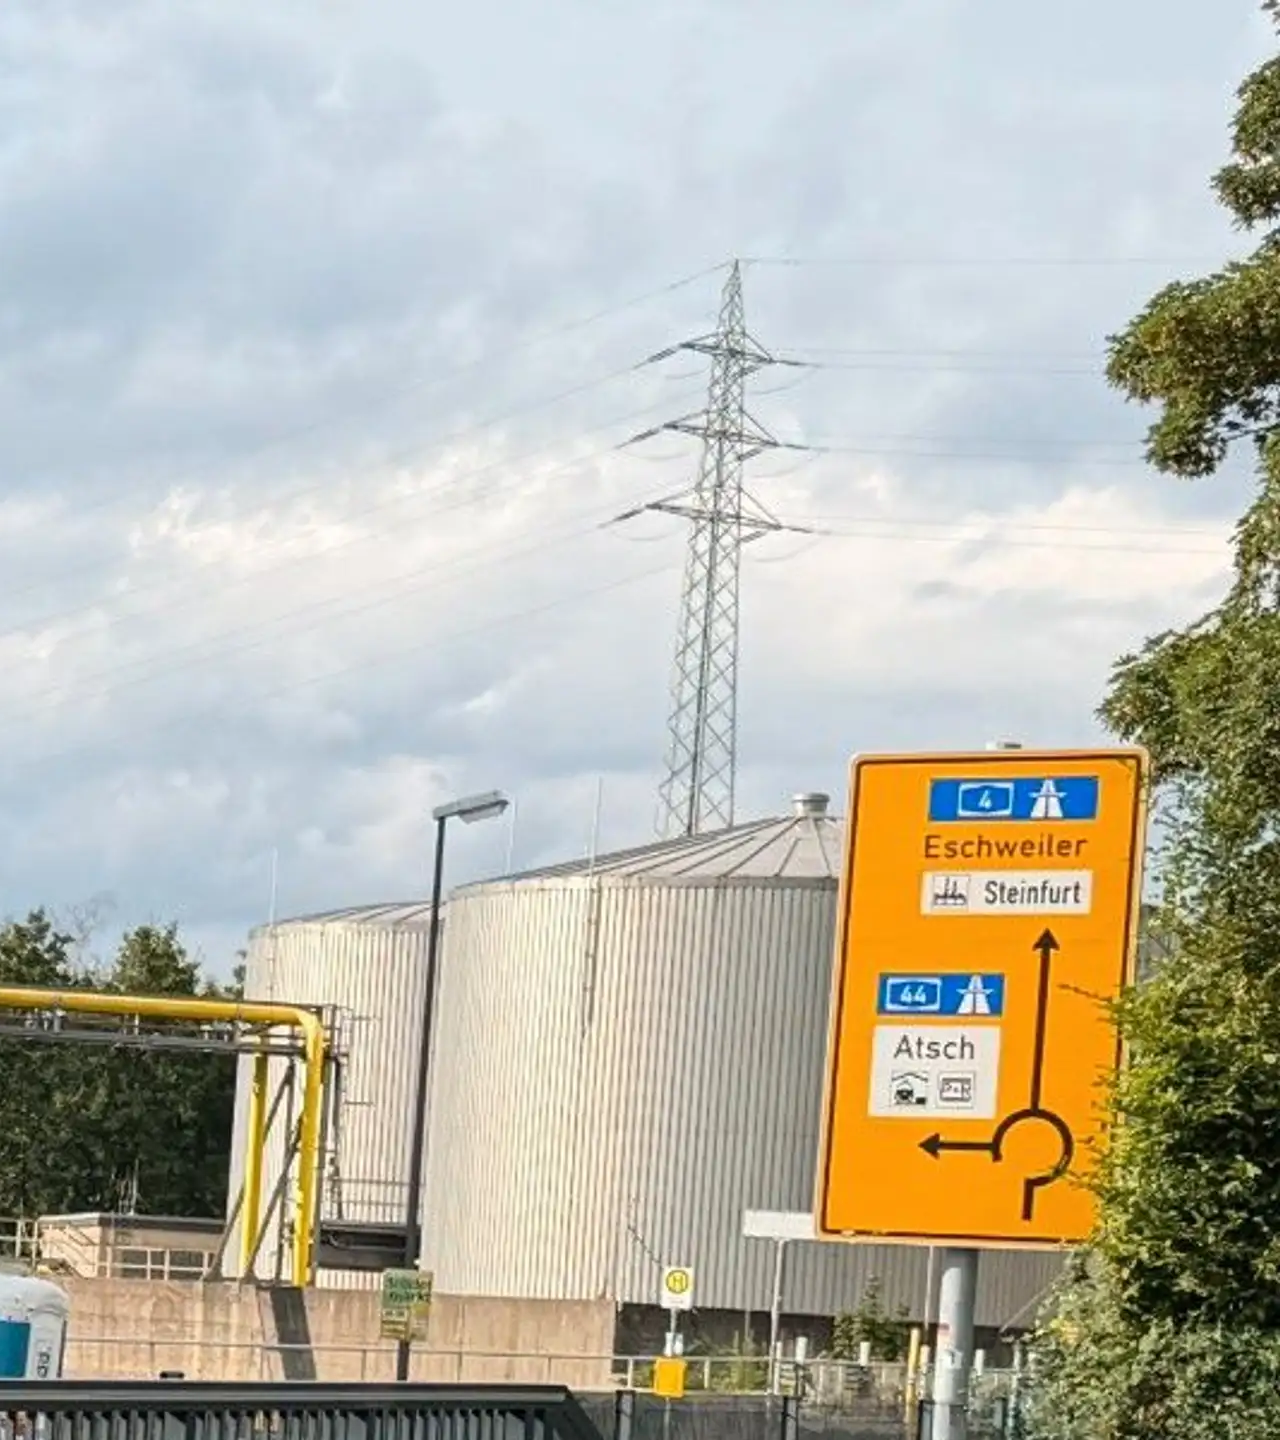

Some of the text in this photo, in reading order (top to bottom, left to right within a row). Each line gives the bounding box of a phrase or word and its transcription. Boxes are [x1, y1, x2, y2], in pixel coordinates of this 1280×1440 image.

[978, 789, 993, 810] 4
[924, 834, 1088, 860] Eschweiler
[984, 879, 1081, 905] Steinfurt
[900, 984, 927, 1004] 44
[894, 1034, 975, 1060] Atsch
